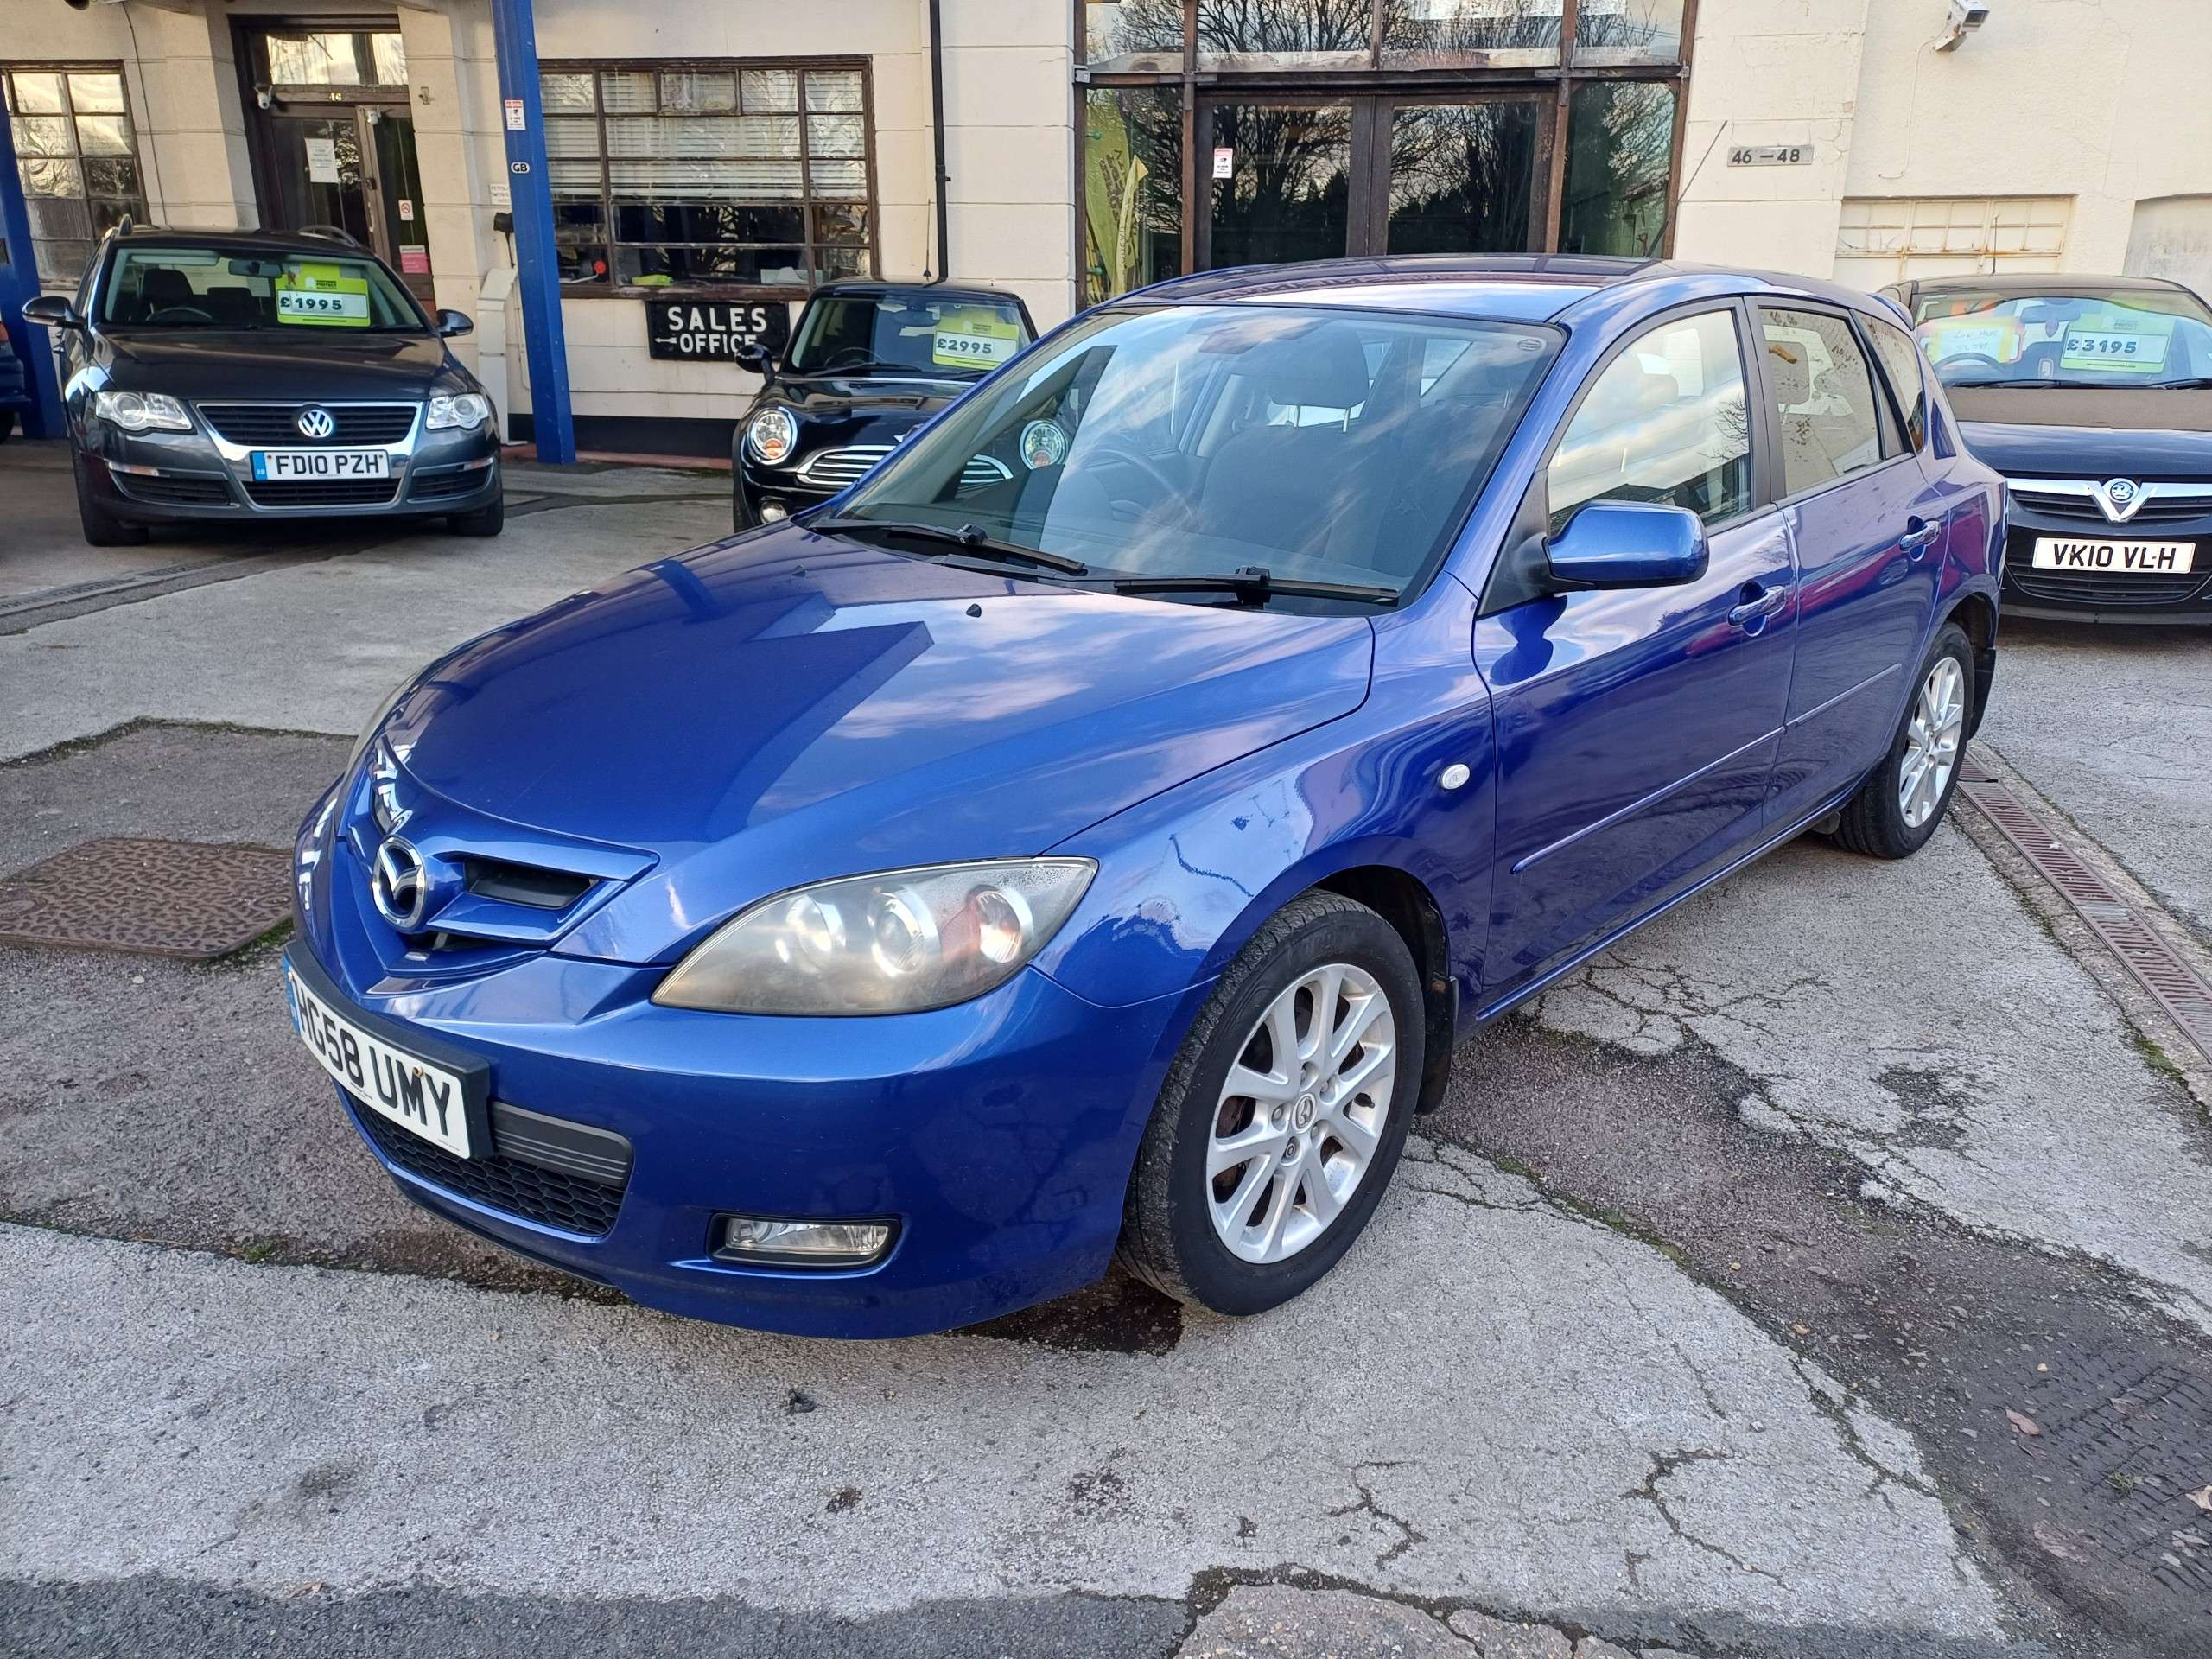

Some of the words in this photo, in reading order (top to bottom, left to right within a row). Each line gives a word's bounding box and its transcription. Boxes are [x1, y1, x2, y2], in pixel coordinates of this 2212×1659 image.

[512, 163, 528, 172] GB
[280, 296, 342, 310] £1995
[667, 306, 767, 332] SALES
[937, 338, 992, 354] £2995
[2066, 339, 2137, 353] £3195
[275, 455, 328, 474] FD10
[334, 454, 379, 474] PZH
[2053, 543, 2113, 568] VK10
[2124, 546, 2177, 569] VLH
[292, 977, 364, 1088] HG58
[368, 1046, 450, 1137] UMY
